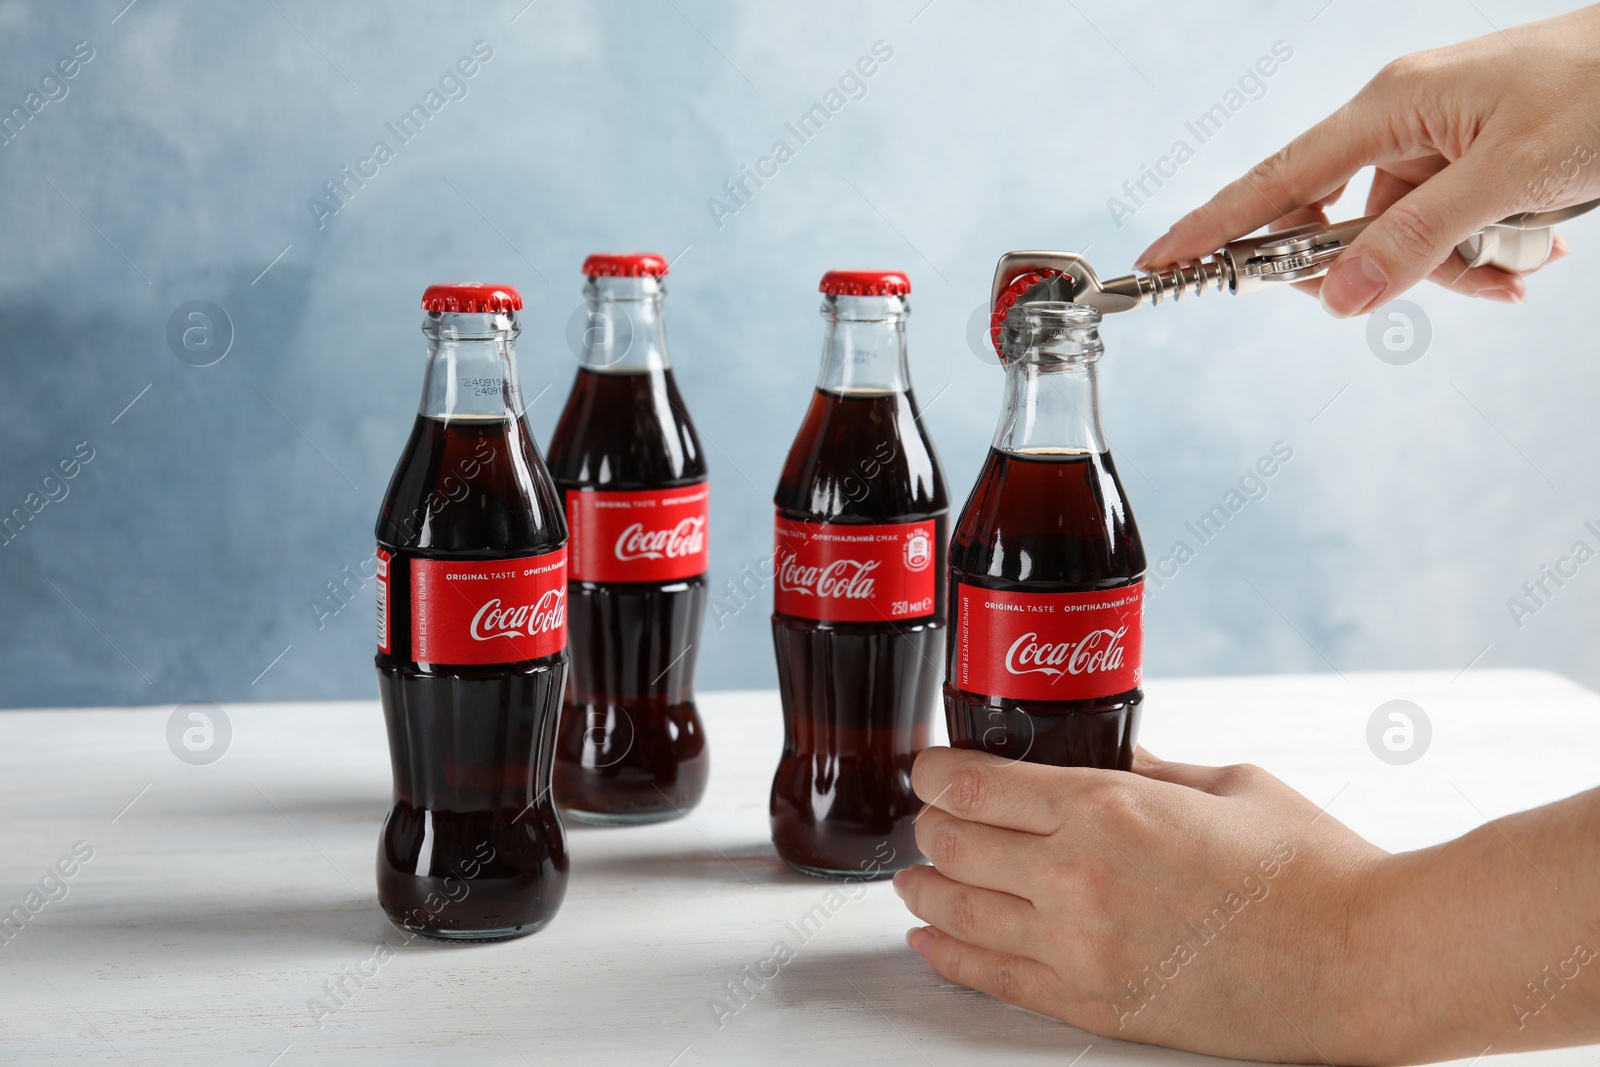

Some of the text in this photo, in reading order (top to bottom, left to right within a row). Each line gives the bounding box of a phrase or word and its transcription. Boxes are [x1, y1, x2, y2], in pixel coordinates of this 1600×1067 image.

[614, 515, 706, 562] Coca-Cola
[814, 533, 899, 543] ОРИГІНАЛЬНИЙ СМАК
[446, 571, 516, 581] ORIGINAL TASTE
[779, 554, 883, 600] Coca-Cola
[470, 585, 566, 641] Coca-Cola
[892, 601, 908, 615] 250
[984, 601, 1055, 613] ORIGINAL TASTE
[1064, 597, 1125, 613] ОРИГІНАЛЬНИЙ
[1005, 624, 1130, 676] Coca-Cola
